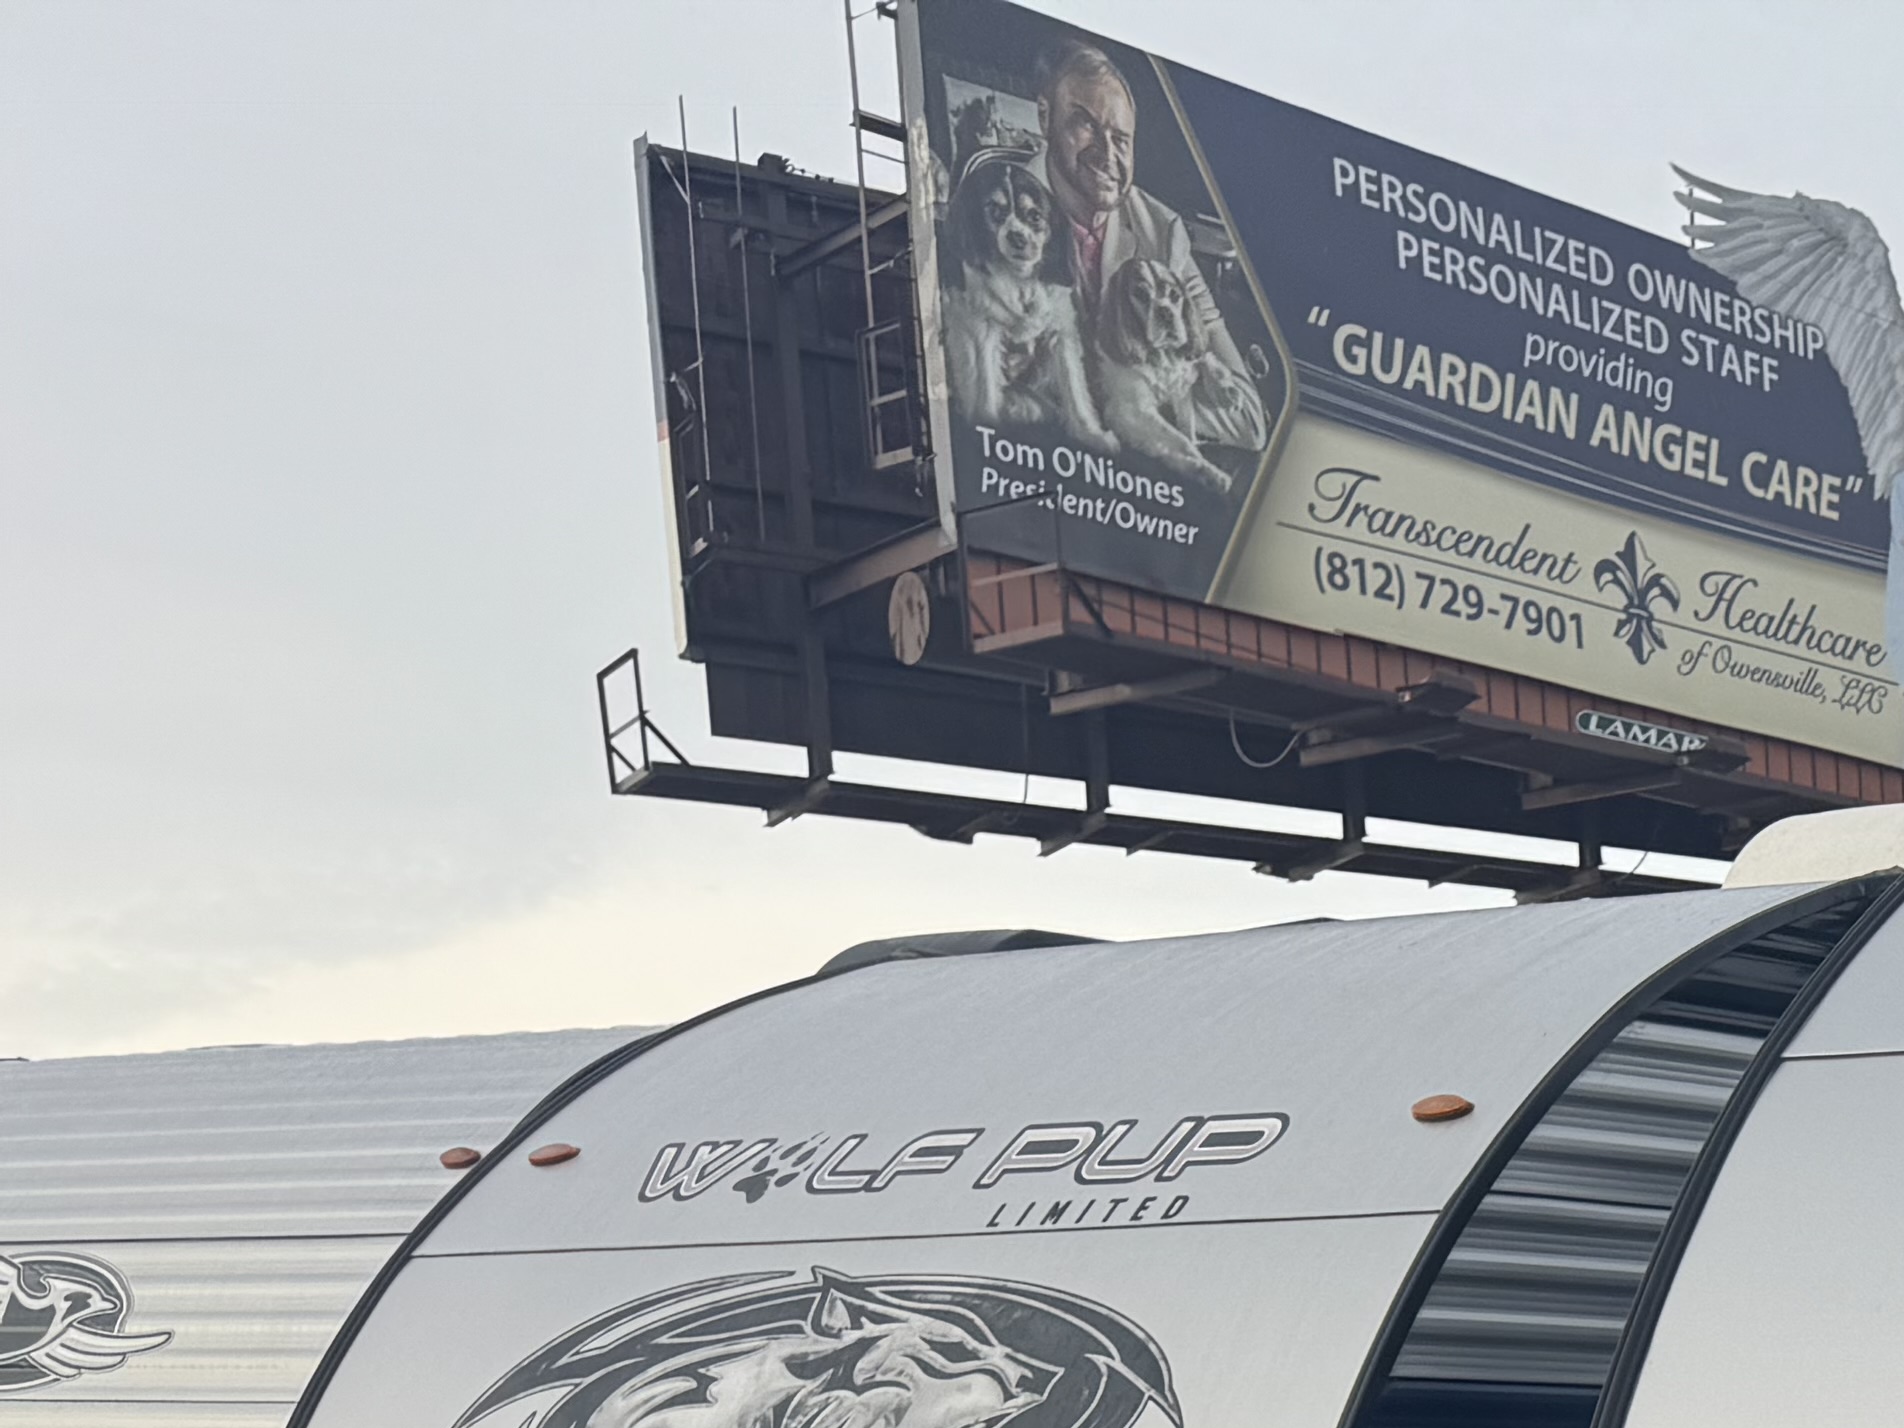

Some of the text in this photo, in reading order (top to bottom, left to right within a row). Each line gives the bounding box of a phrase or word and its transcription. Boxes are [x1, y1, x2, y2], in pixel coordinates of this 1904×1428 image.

[1332, 157, 1826, 361] PERSONALIZED OWNERSHIP
[1397, 229, 1780, 393] PERSONALIZED STAFF
[1523, 331, 1675, 413] providing
[975, 424, 1185, 507] Tom O'Niones
[1589, 402, 1729, 488] ANGEL
[1307, 466, 1888, 667] Transcendent Healthcare
[1313, 544, 1585, 650] (812) 729-7901
[1676, 641, 1711, 677] of
[1711, 645, 1830, 705] Owensville,
[1586, 714, 1708, 754] LAMAR
[972, 1112, 1291, 1190] PUP
[986, 1194, 1190, 1229] LIMITED
